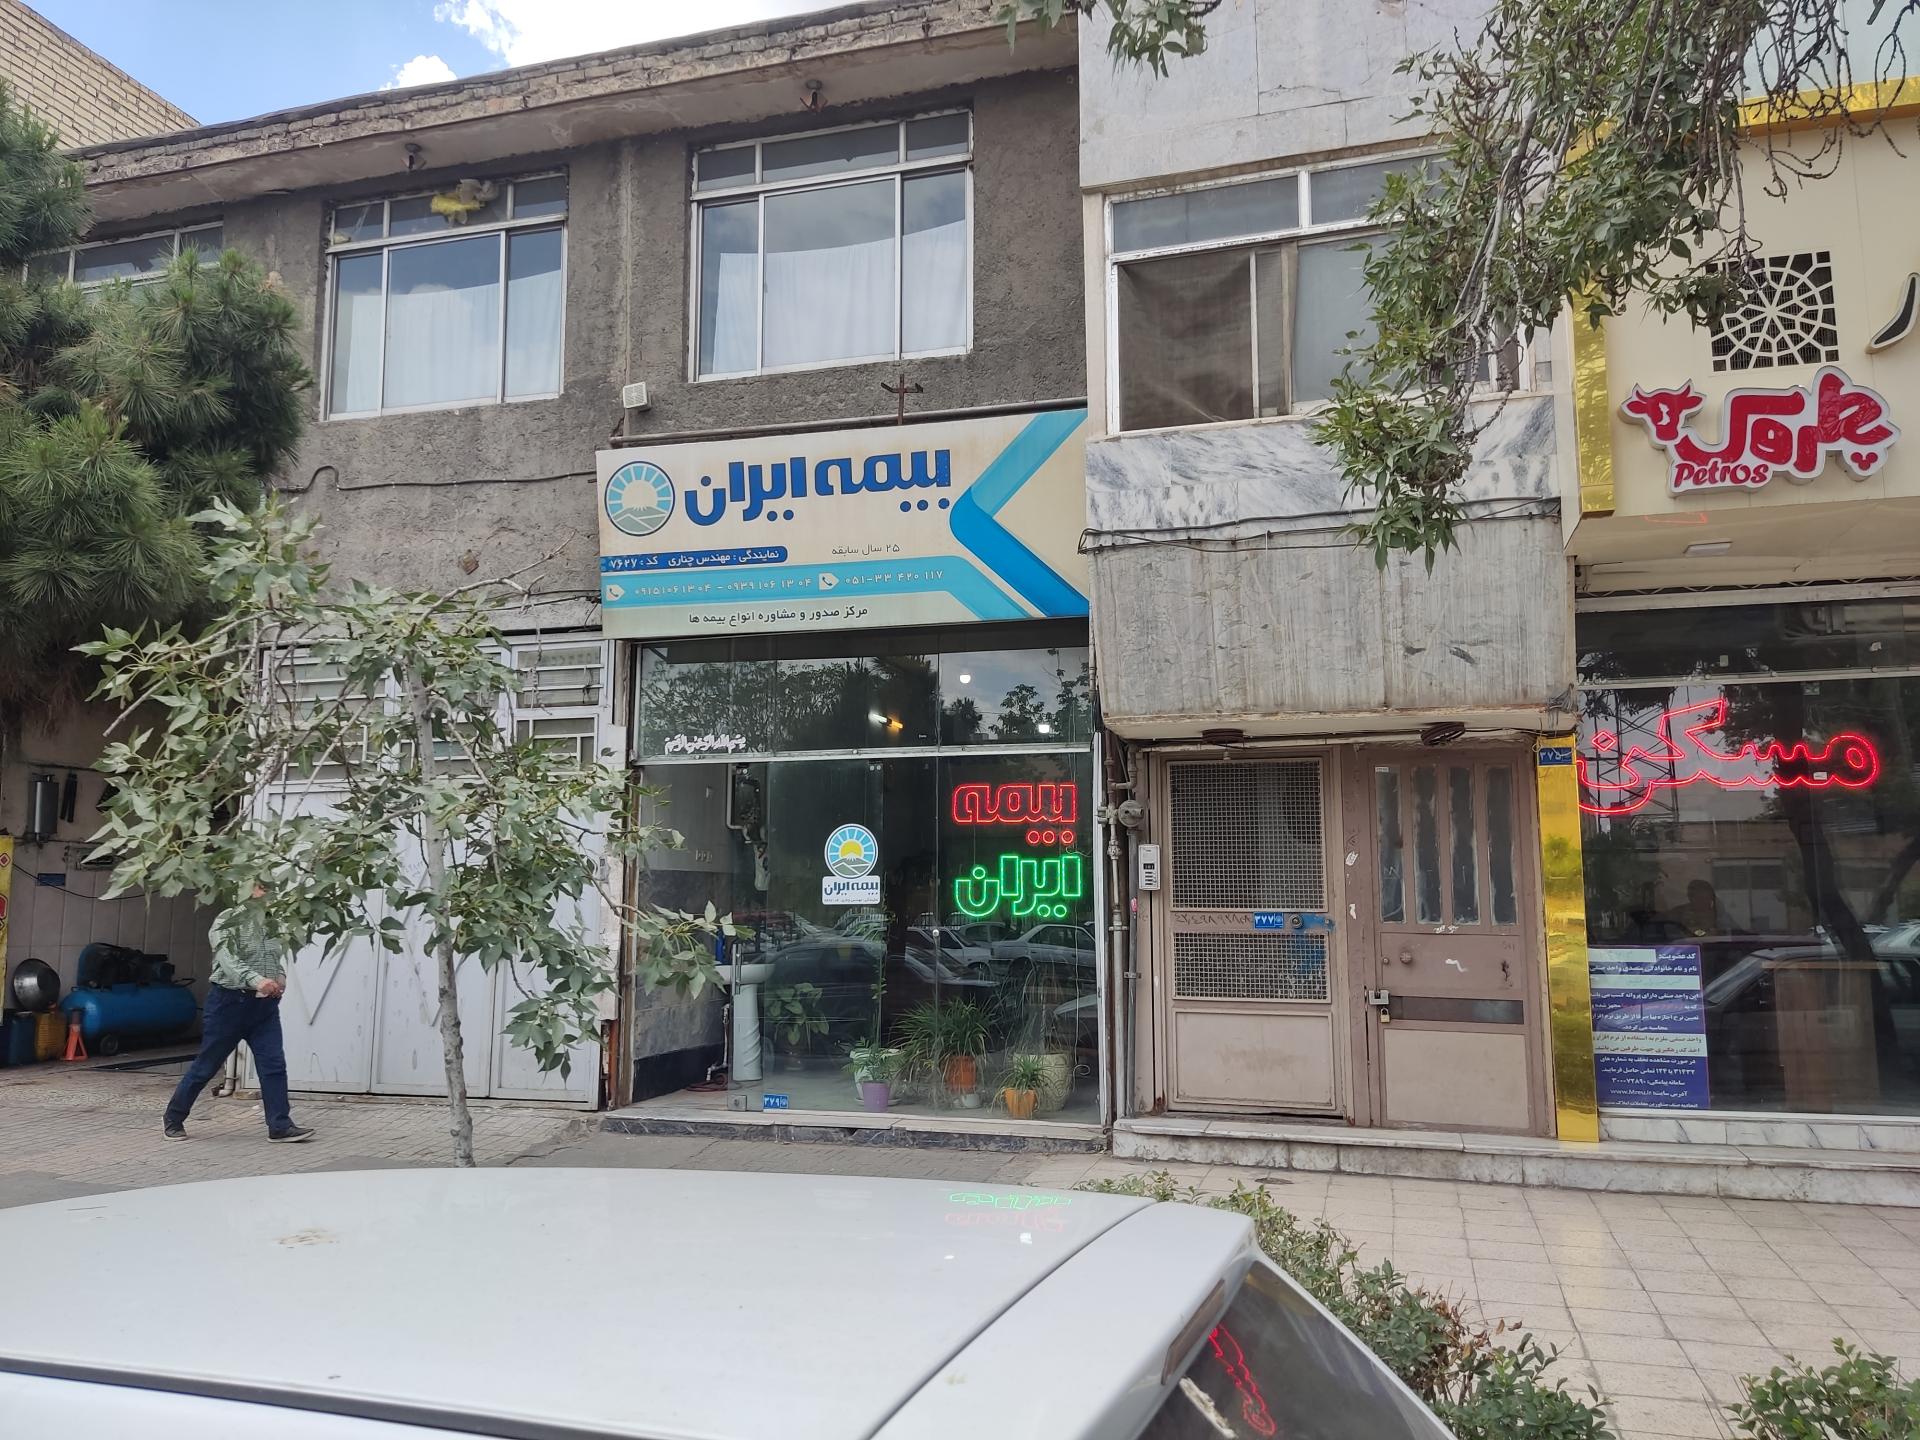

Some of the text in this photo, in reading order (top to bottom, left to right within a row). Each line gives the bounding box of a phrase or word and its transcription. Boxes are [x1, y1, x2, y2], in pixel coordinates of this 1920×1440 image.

[1674, 461, 1769, 488] Petros
[684, 449, 951, 526] بیمه ایران
[832, 543, 900, 556] ۲۵ سال سابقه
[610, 558, 638, 568] ۷۶۲۷
[646, 556, 658, 565] کد
[668, 554, 694, 566] چناری
[696, 553, 731, 565] مهندس
[689, 605, 868, 627] مرکز صدور و مشاوره انواع بیمه ها
[1577, 698, 1880, 817] مسکن
[952, 783, 1078, 845] بیمه
[824, 881, 879, 896] بیمه ایران
[954, 854, 1082, 918] ایران
[1254, 914, 1275, 926] ۳۷۷
